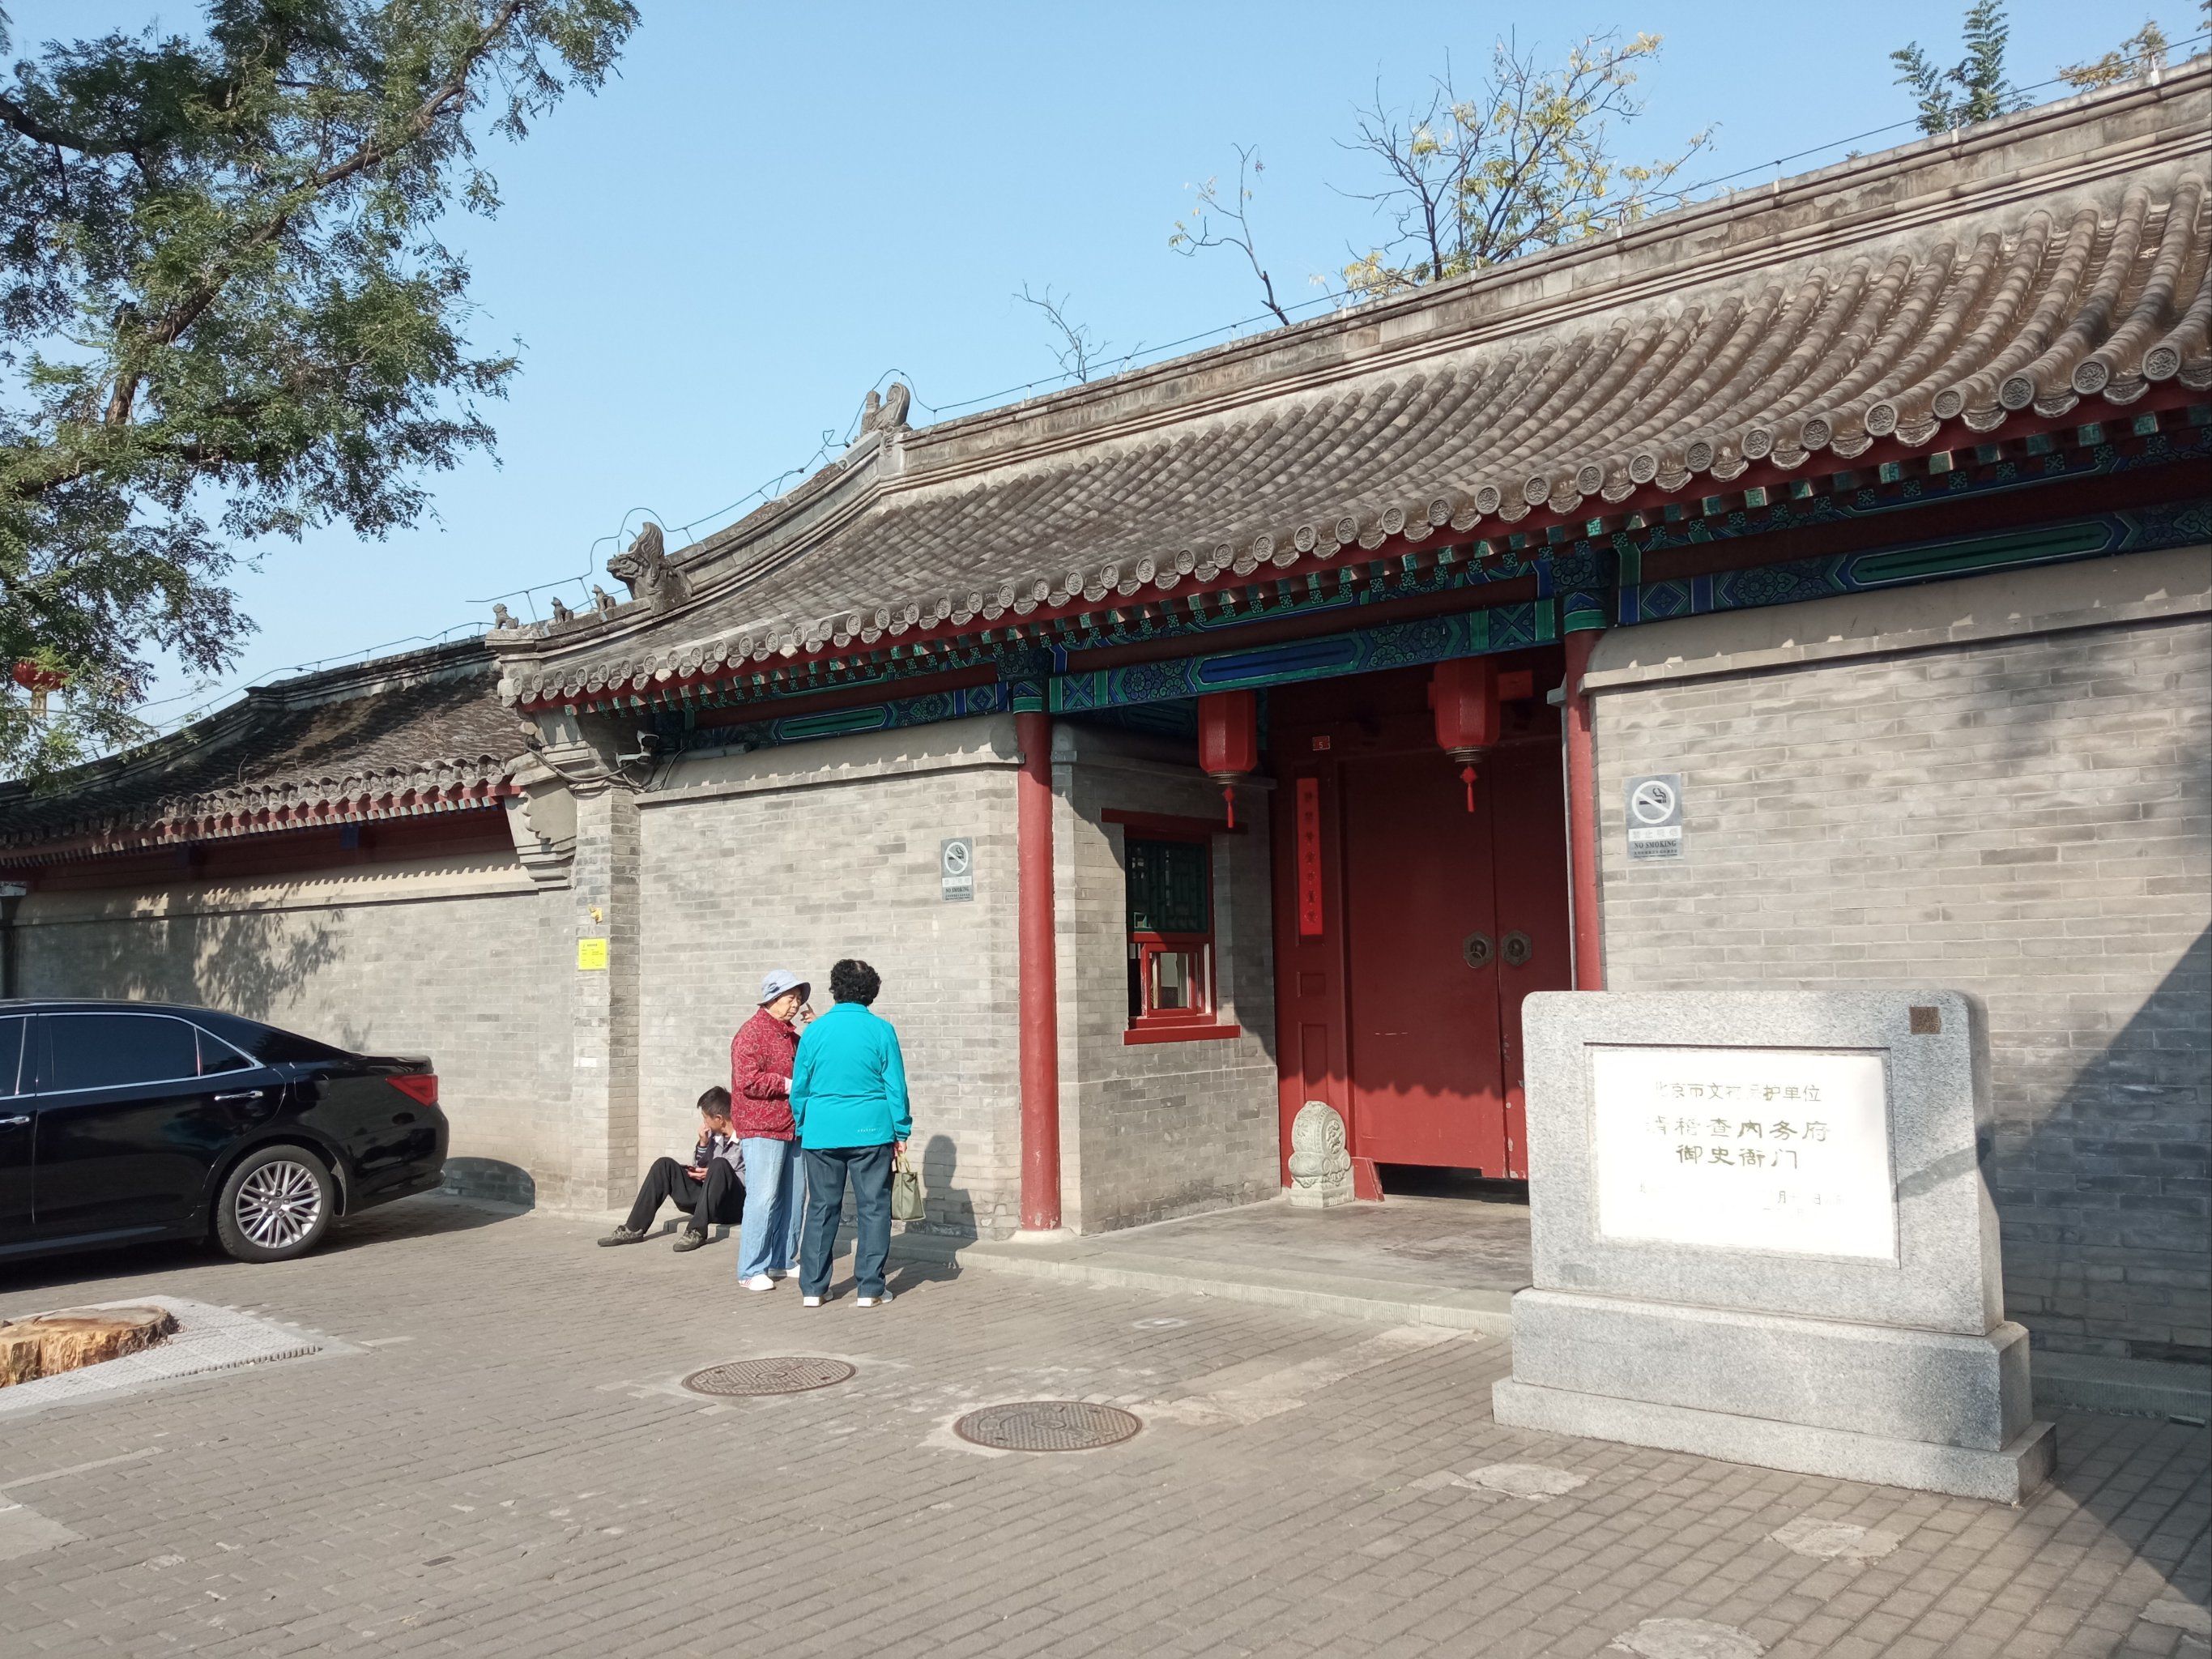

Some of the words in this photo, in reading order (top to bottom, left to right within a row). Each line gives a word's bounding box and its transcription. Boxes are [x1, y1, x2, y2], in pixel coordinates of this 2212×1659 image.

[1645, 840, 1677, 849] SMOKING
[1675, 1145, 1798, 1170] 御史衙门
